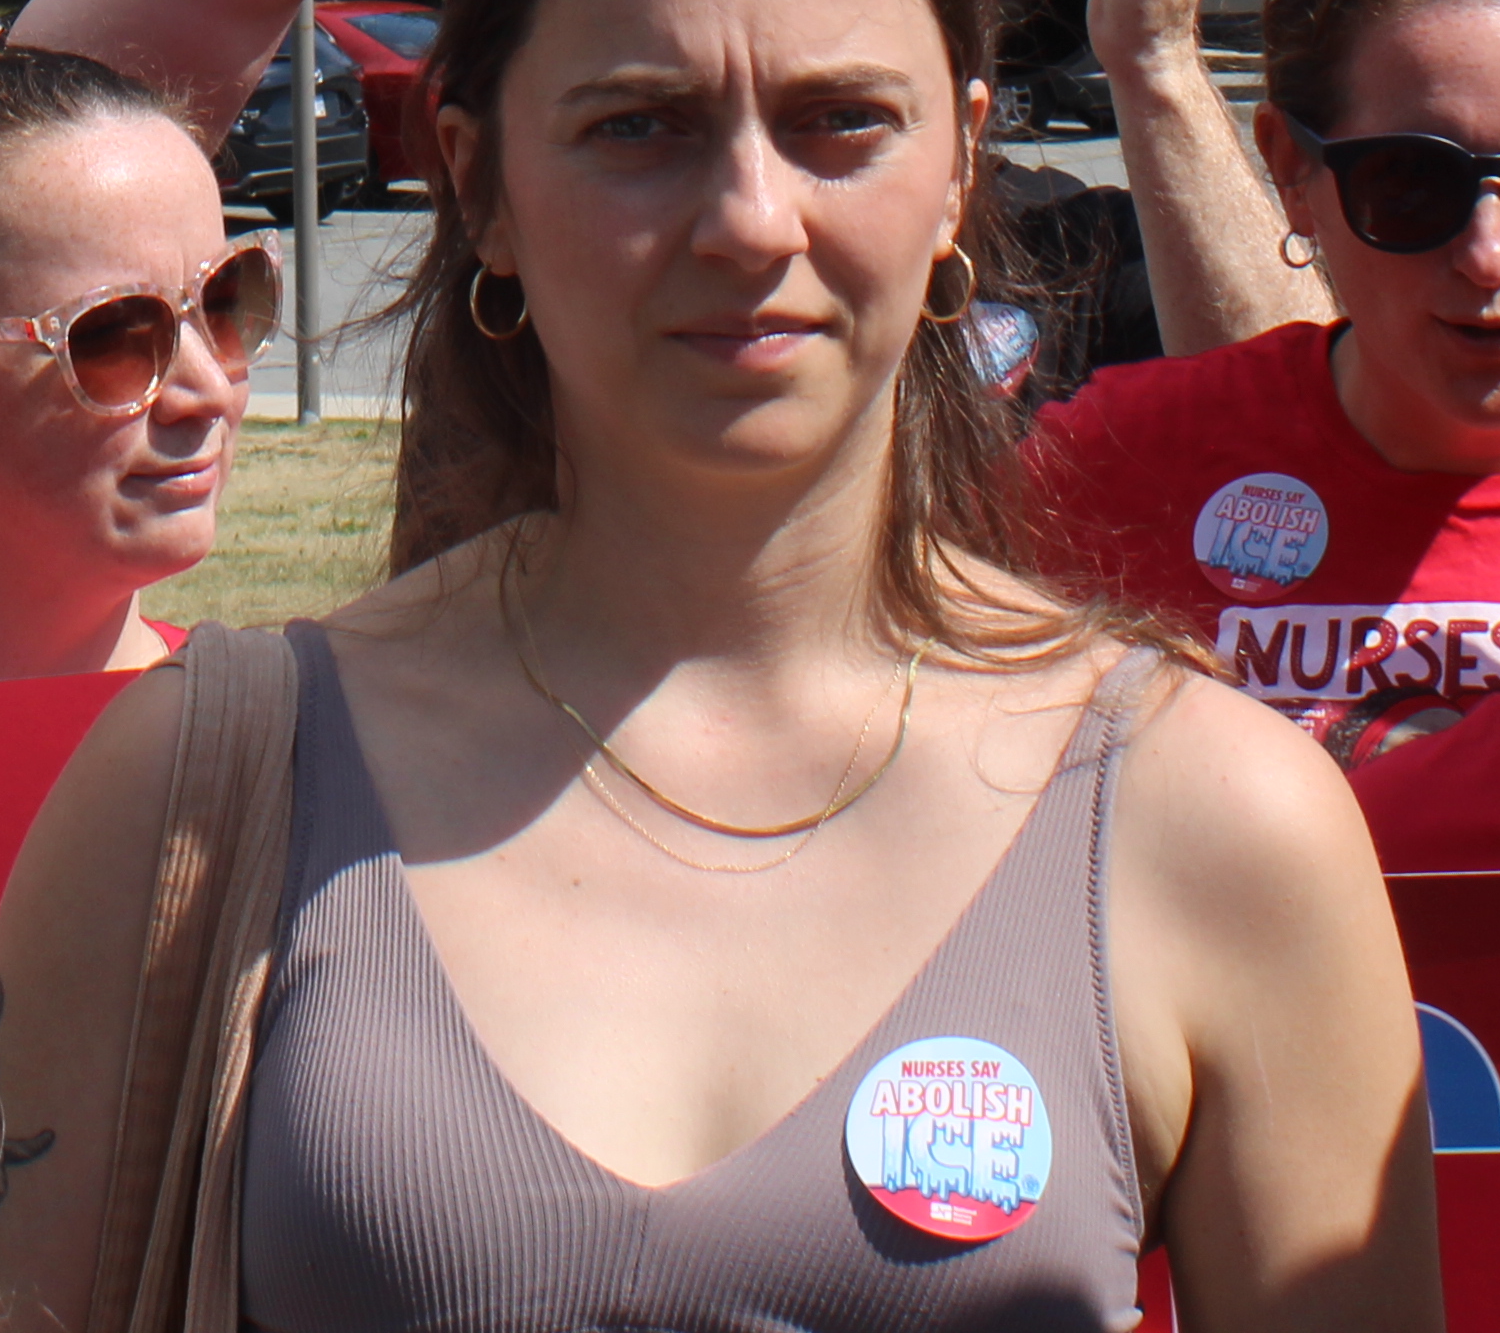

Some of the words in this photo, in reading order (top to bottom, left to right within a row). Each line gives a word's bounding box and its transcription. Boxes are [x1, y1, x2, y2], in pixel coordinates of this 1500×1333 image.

[1214, 493, 1321, 535] ABOLISH
[901, 1060, 966, 1078] NURSES
[971, 1060, 1002, 1080] SAY
[870, 1079, 1034, 1128] ABOLISH
